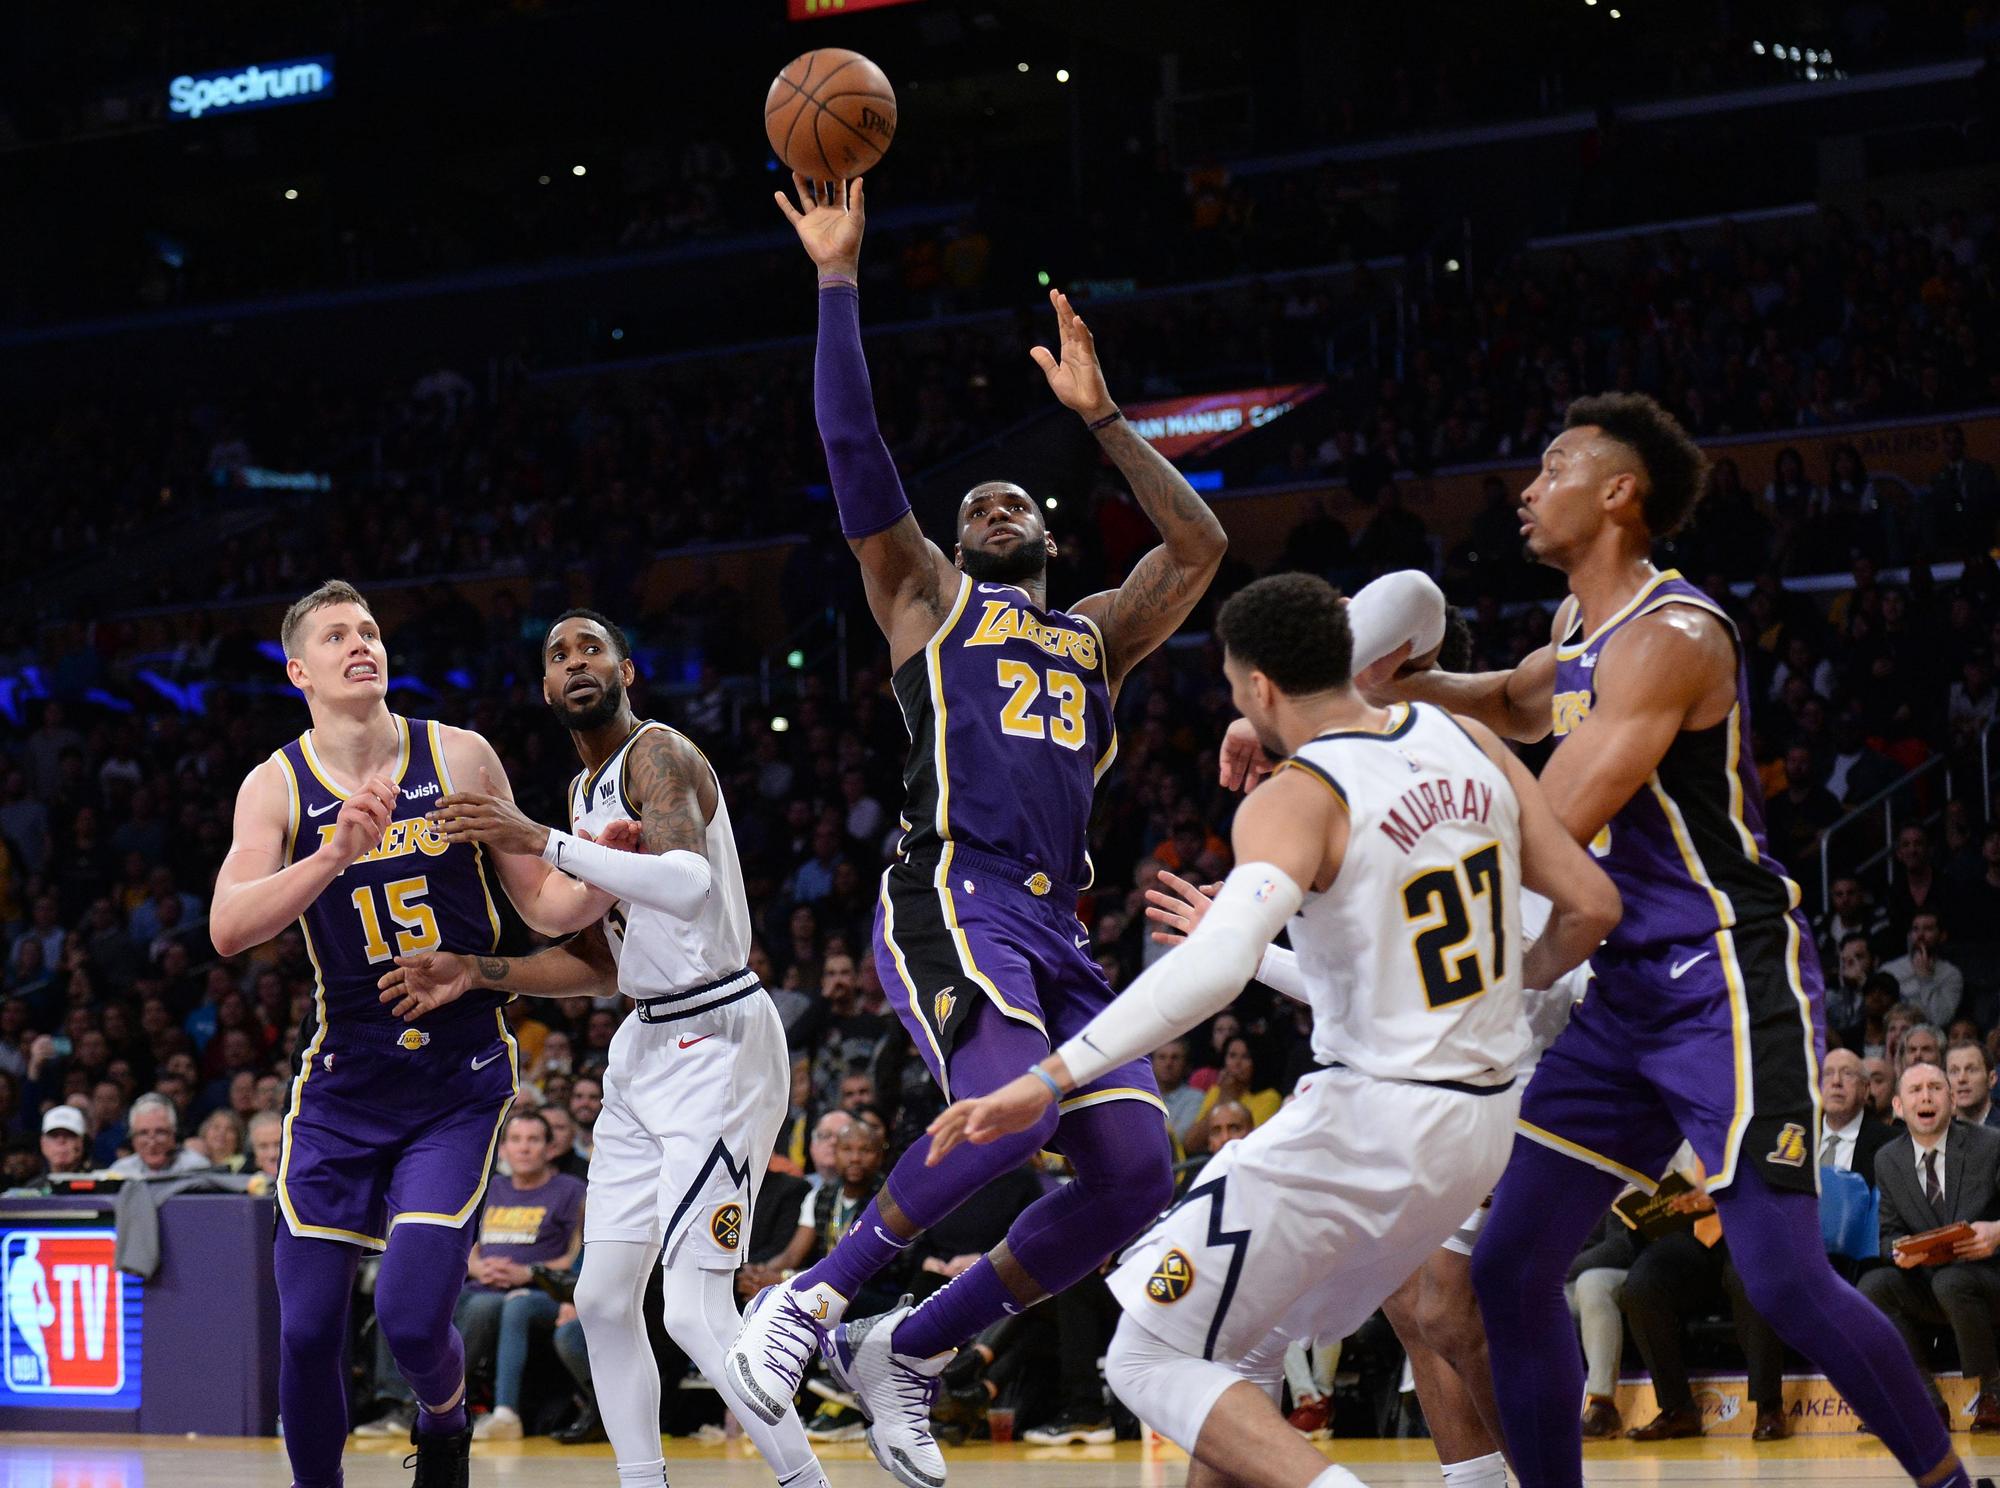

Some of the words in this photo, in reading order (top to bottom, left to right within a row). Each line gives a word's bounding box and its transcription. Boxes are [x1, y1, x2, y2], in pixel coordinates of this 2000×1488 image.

[169, 62, 323, 118] Spectrum
[856, 107, 894, 137] SPAL
[963, 600, 1098, 671] LAKERS
[997, 658, 1087, 751] 23
[402, 781, 439, 800] wish
[1379, 778, 1492, 855] MURRAY
[351, 875, 442, 965] 15
[1400, 839, 1505, 1012] 27
[53, 1264, 109, 1361] TV
[1785, 1397, 1859, 1419] AKER
